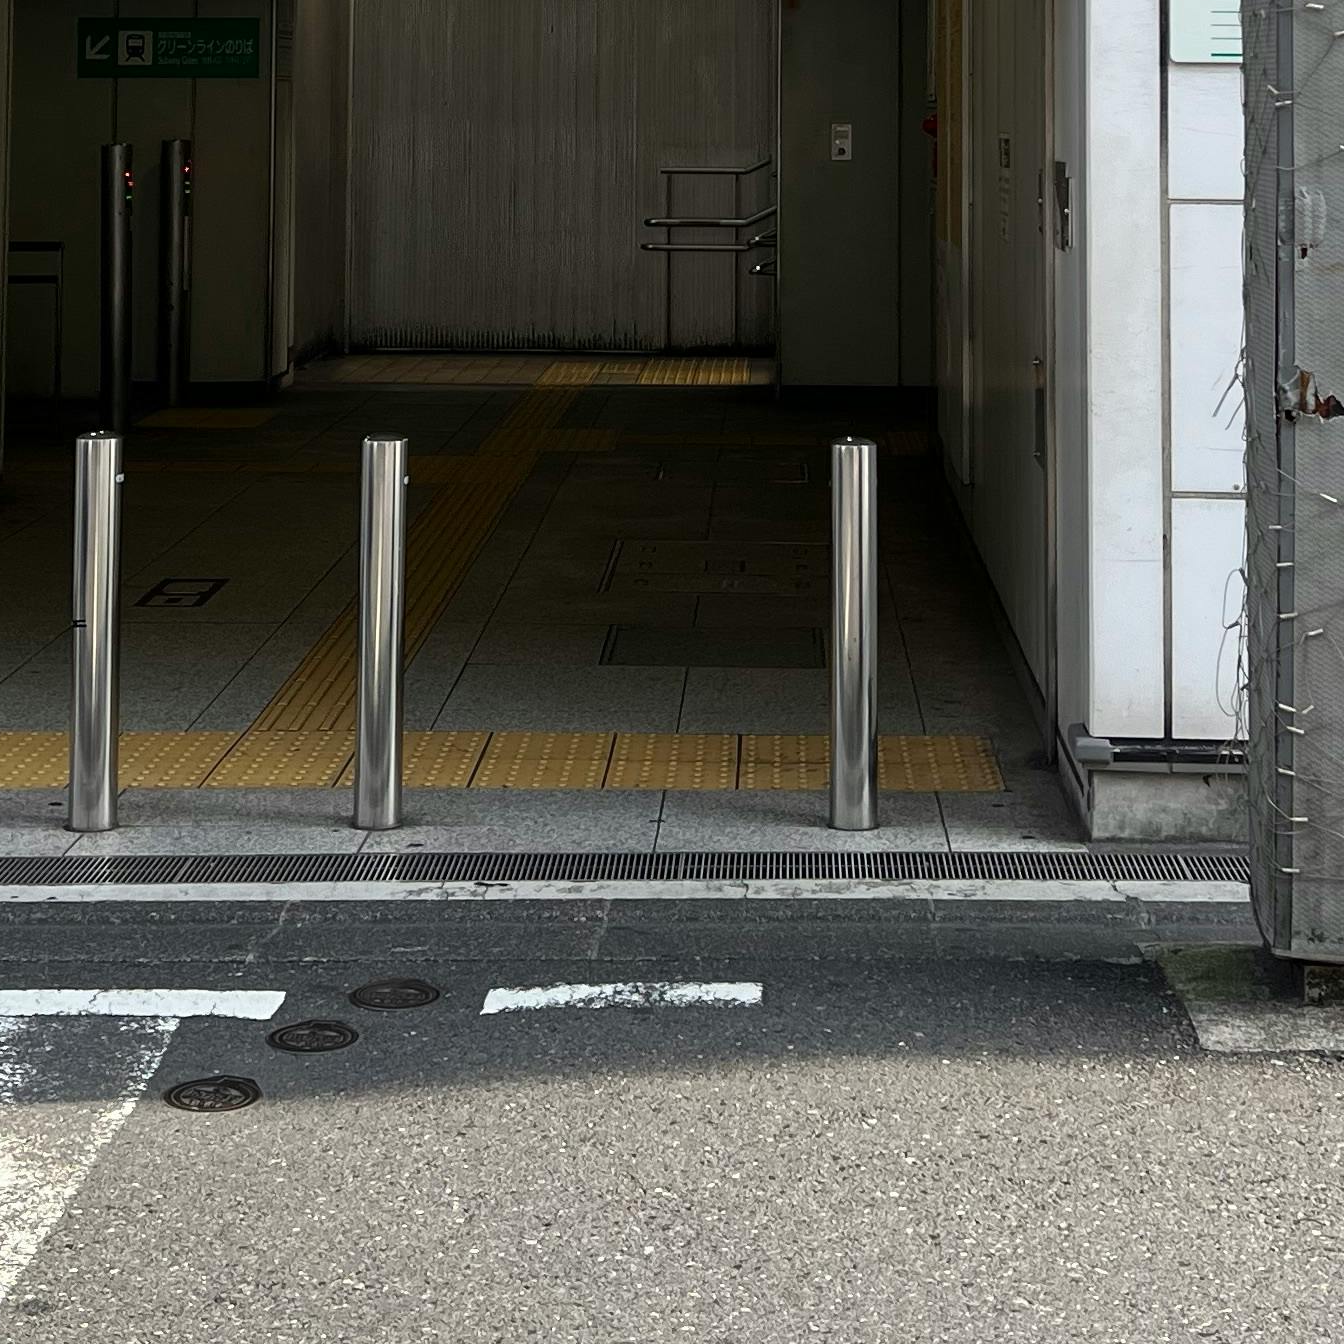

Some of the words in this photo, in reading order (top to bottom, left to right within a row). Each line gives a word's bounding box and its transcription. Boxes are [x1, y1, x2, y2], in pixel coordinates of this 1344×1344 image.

[157, 39, 255, 55] グリーンラインのりば
